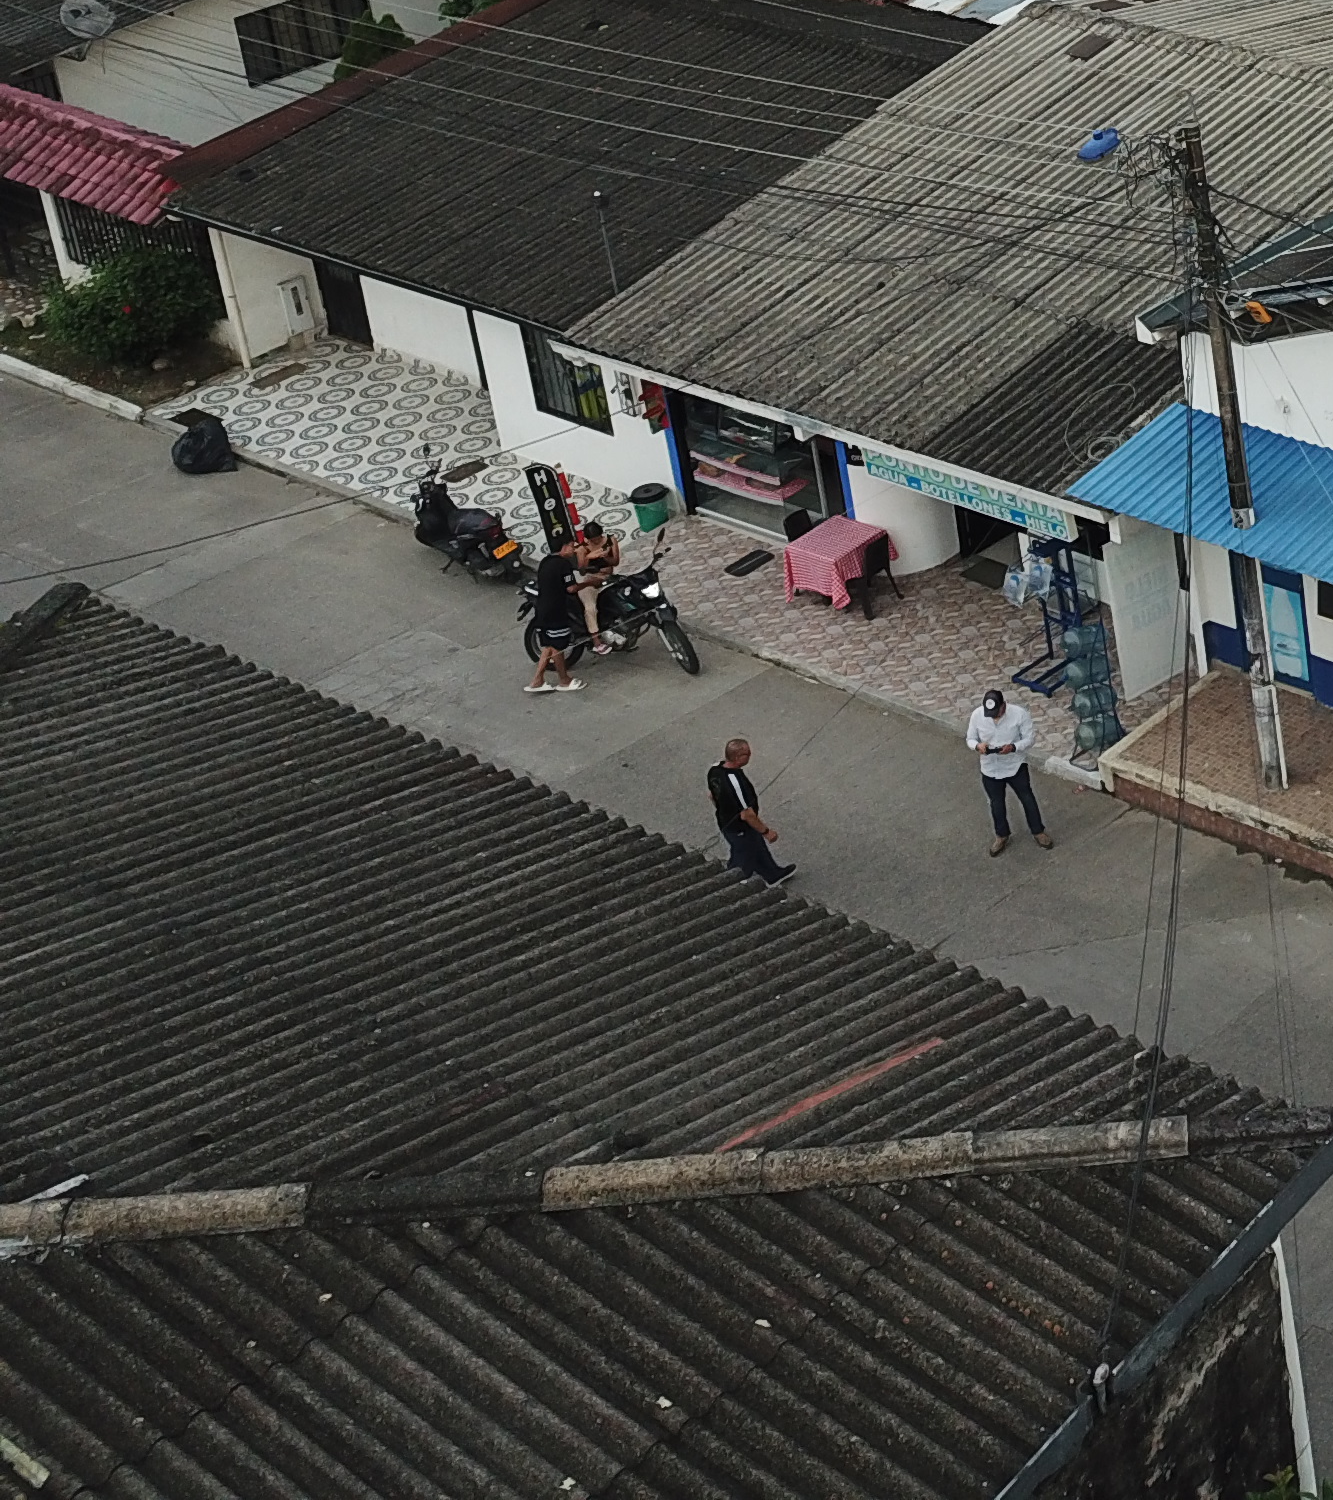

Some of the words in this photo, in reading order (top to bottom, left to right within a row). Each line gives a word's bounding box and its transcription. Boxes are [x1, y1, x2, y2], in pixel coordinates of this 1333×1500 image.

[871, 464, 909, 486] AGUA
[921, 480, 1012, 522] BOTELLONES
[1025, 514, 1067, 539] HIELO
[986, 485, 1064, 522] VENTA
